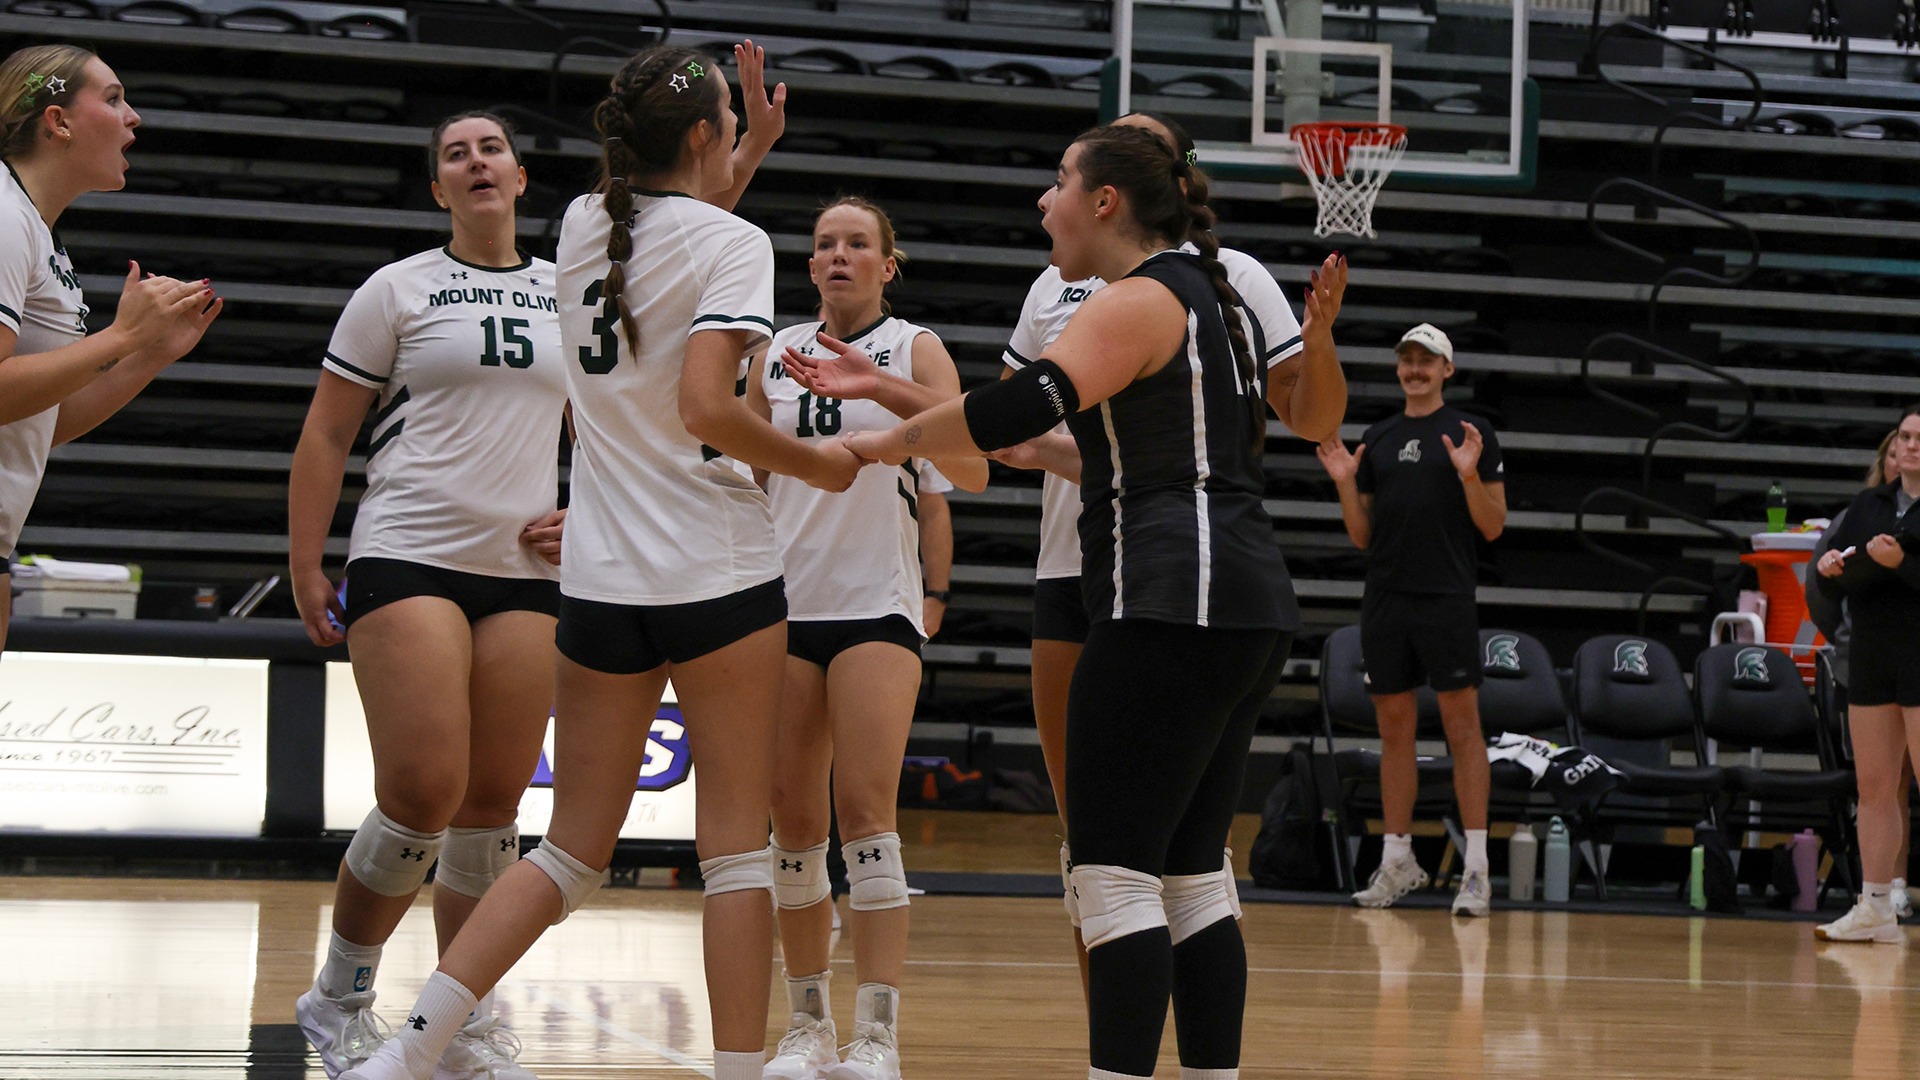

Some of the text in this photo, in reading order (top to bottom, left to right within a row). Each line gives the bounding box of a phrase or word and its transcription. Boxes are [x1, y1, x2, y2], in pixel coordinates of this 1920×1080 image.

[429, 287, 504, 307] MOUNT
[480, 316, 534, 369] 15
[579, 279, 621, 374] 3
[796, 390, 842, 437] 18
[0, 701, 68, 737] sed
[54, 749, 113, 764] 1967
